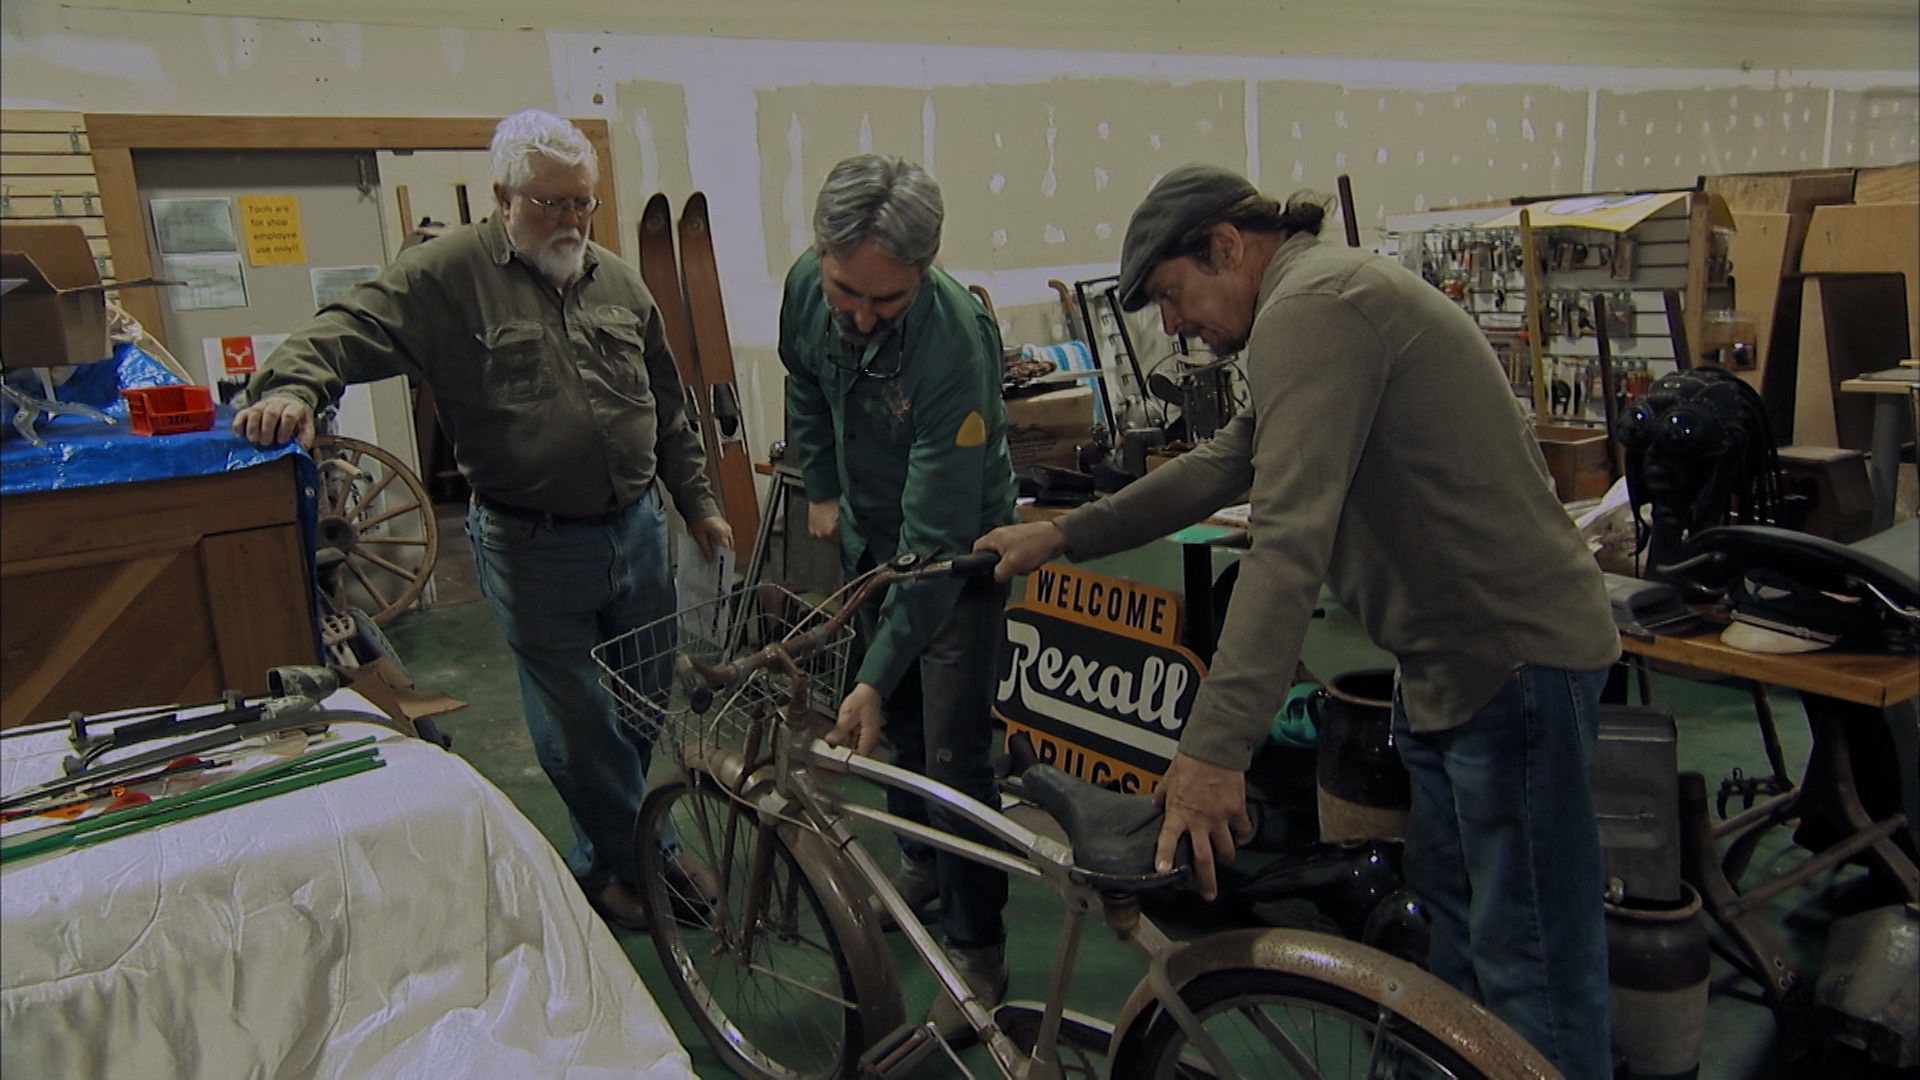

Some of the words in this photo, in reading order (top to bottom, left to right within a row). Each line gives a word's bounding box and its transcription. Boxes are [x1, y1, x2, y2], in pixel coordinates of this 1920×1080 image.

[248, 204, 273, 214] Tools
[275, 205, 289, 213] are
[250, 218, 264, 227] for
[266, 217, 288, 229] shop
[255, 246, 271, 254] use
[1038, 569, 1166, 634] WELCOME
[997, 618, 1189, 731] Rexall
[1012, 731, 1141, 794] RUGS
